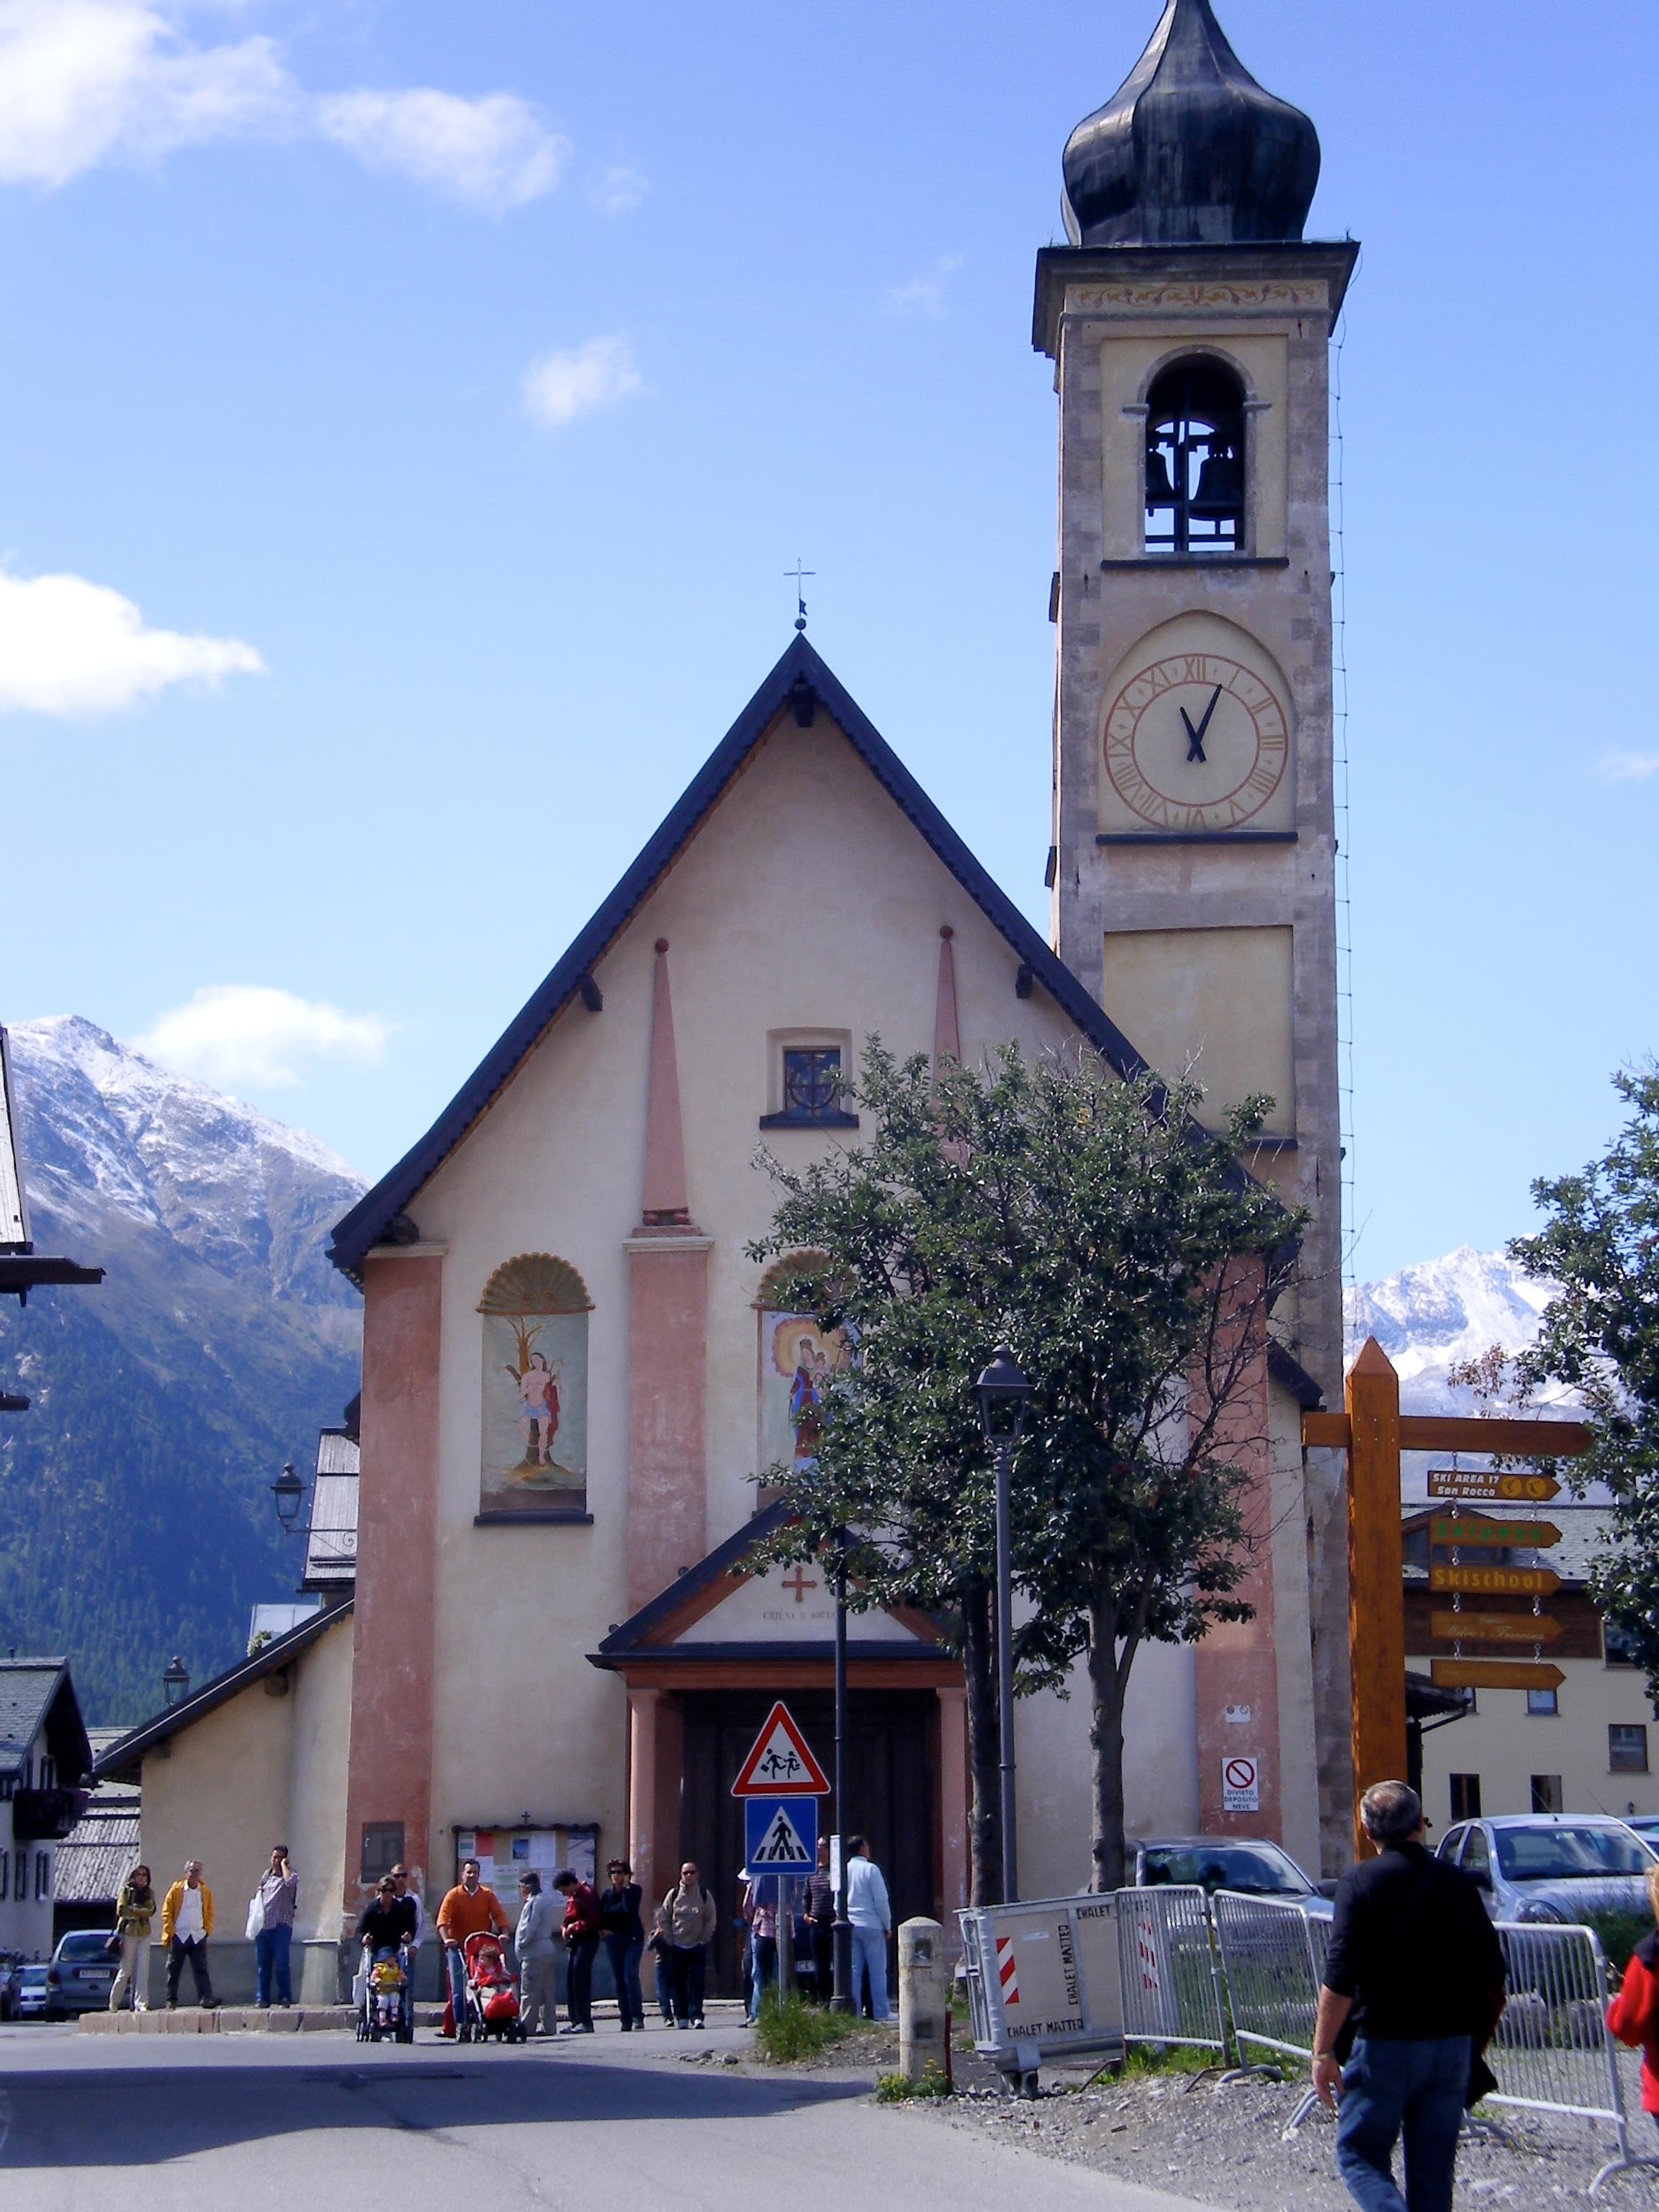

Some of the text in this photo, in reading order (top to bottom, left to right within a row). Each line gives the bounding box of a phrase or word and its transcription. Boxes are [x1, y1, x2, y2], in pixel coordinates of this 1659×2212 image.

[1183, 656, 1206, 681] XII
[1433, 1473, 1499, 1484] SKI AREA 17
[1437, 1485, 1496, 1497] San Rocco
[1434, 1569, 1542, 1588] Skischool
[1076, 1905, 1110, 1920] CHALET
[1064, 1969, 1078, 2005] CHALET
[1007, 2023, 1042, 2038] CHALET
